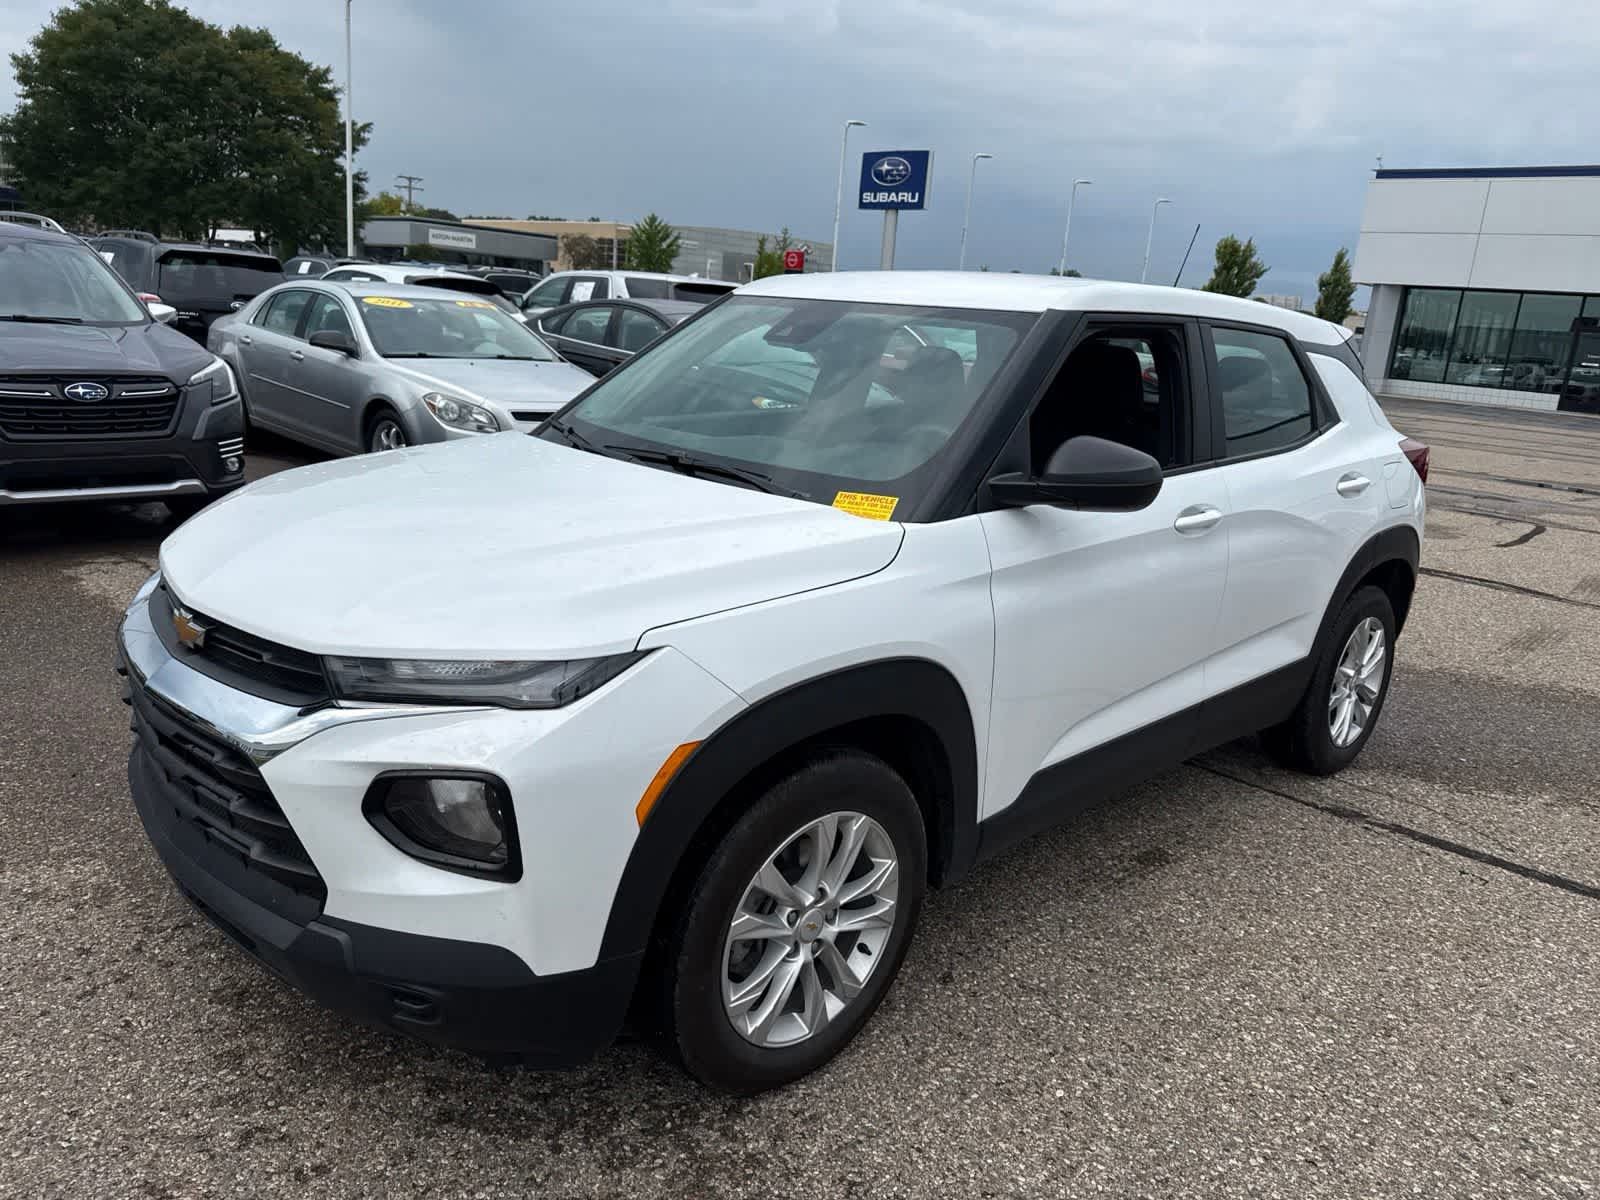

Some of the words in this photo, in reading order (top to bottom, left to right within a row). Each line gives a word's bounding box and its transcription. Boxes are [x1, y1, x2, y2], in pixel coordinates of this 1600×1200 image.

[862, 192, 919, 203] SUBARU
[451, 235, 473, 243] MARTIN
[838, 493, 857, 501] THIS
[860, 495, 897, 505] VEHICLE
